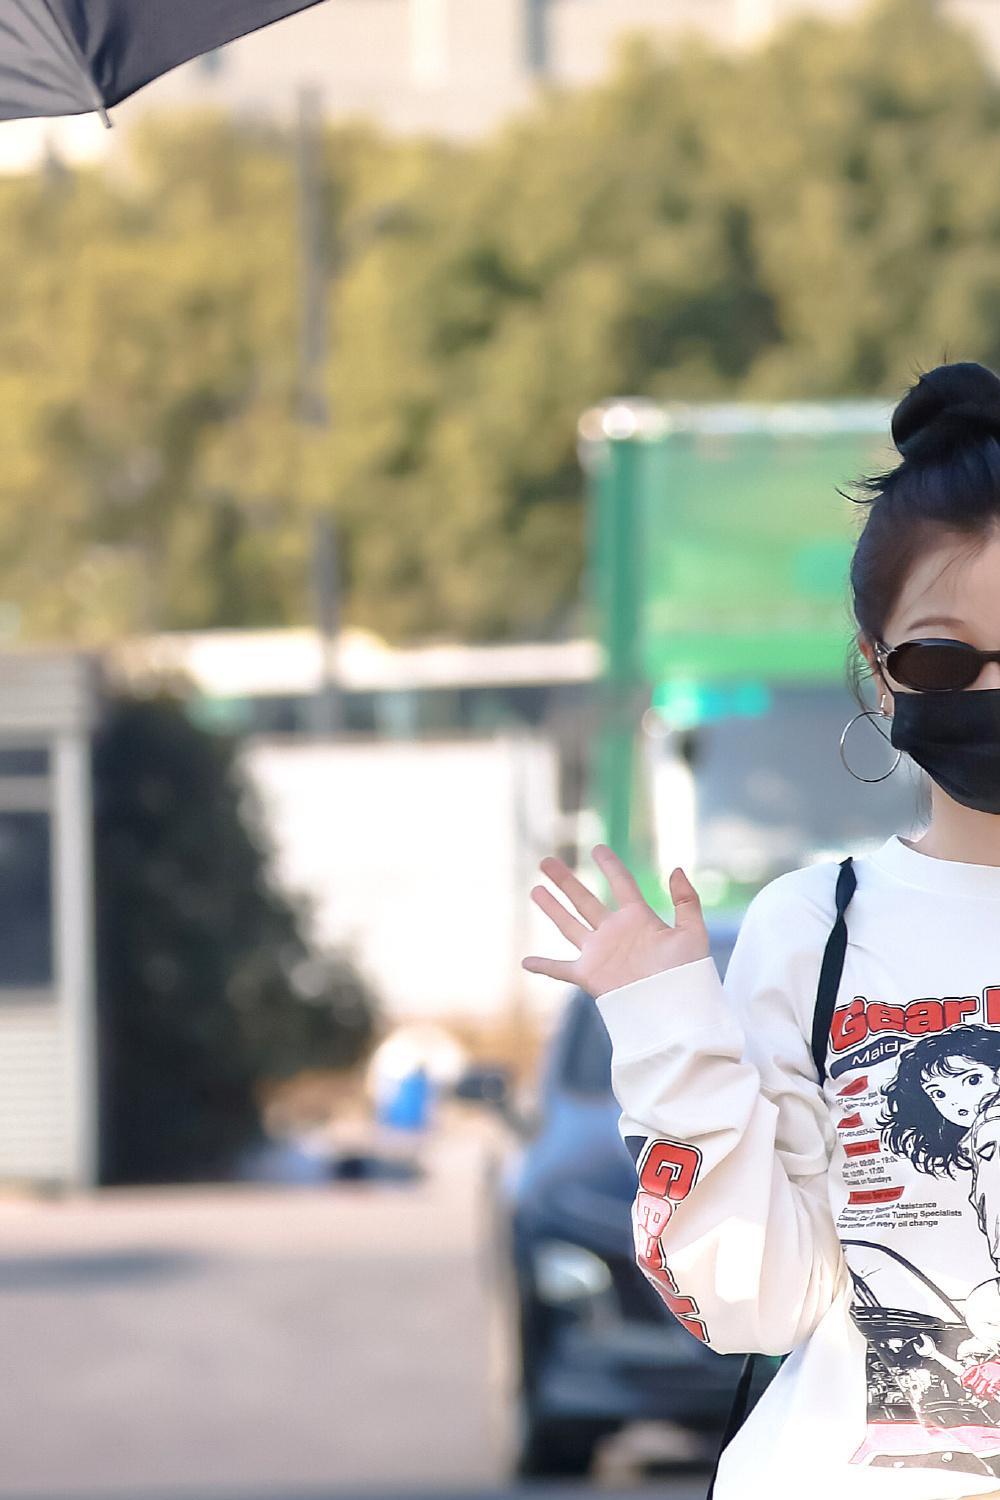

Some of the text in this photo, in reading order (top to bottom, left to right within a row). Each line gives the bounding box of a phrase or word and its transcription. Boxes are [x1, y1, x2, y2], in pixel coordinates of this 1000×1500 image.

[830, 998, 978, 1052] Gear
[896, 1202, 937, 1210] Assistance
[892, 1211, 919, 1219] Tuning
[920, 1210, 962, 1218] Specialists
[909, 1219, 939, 1227] change
